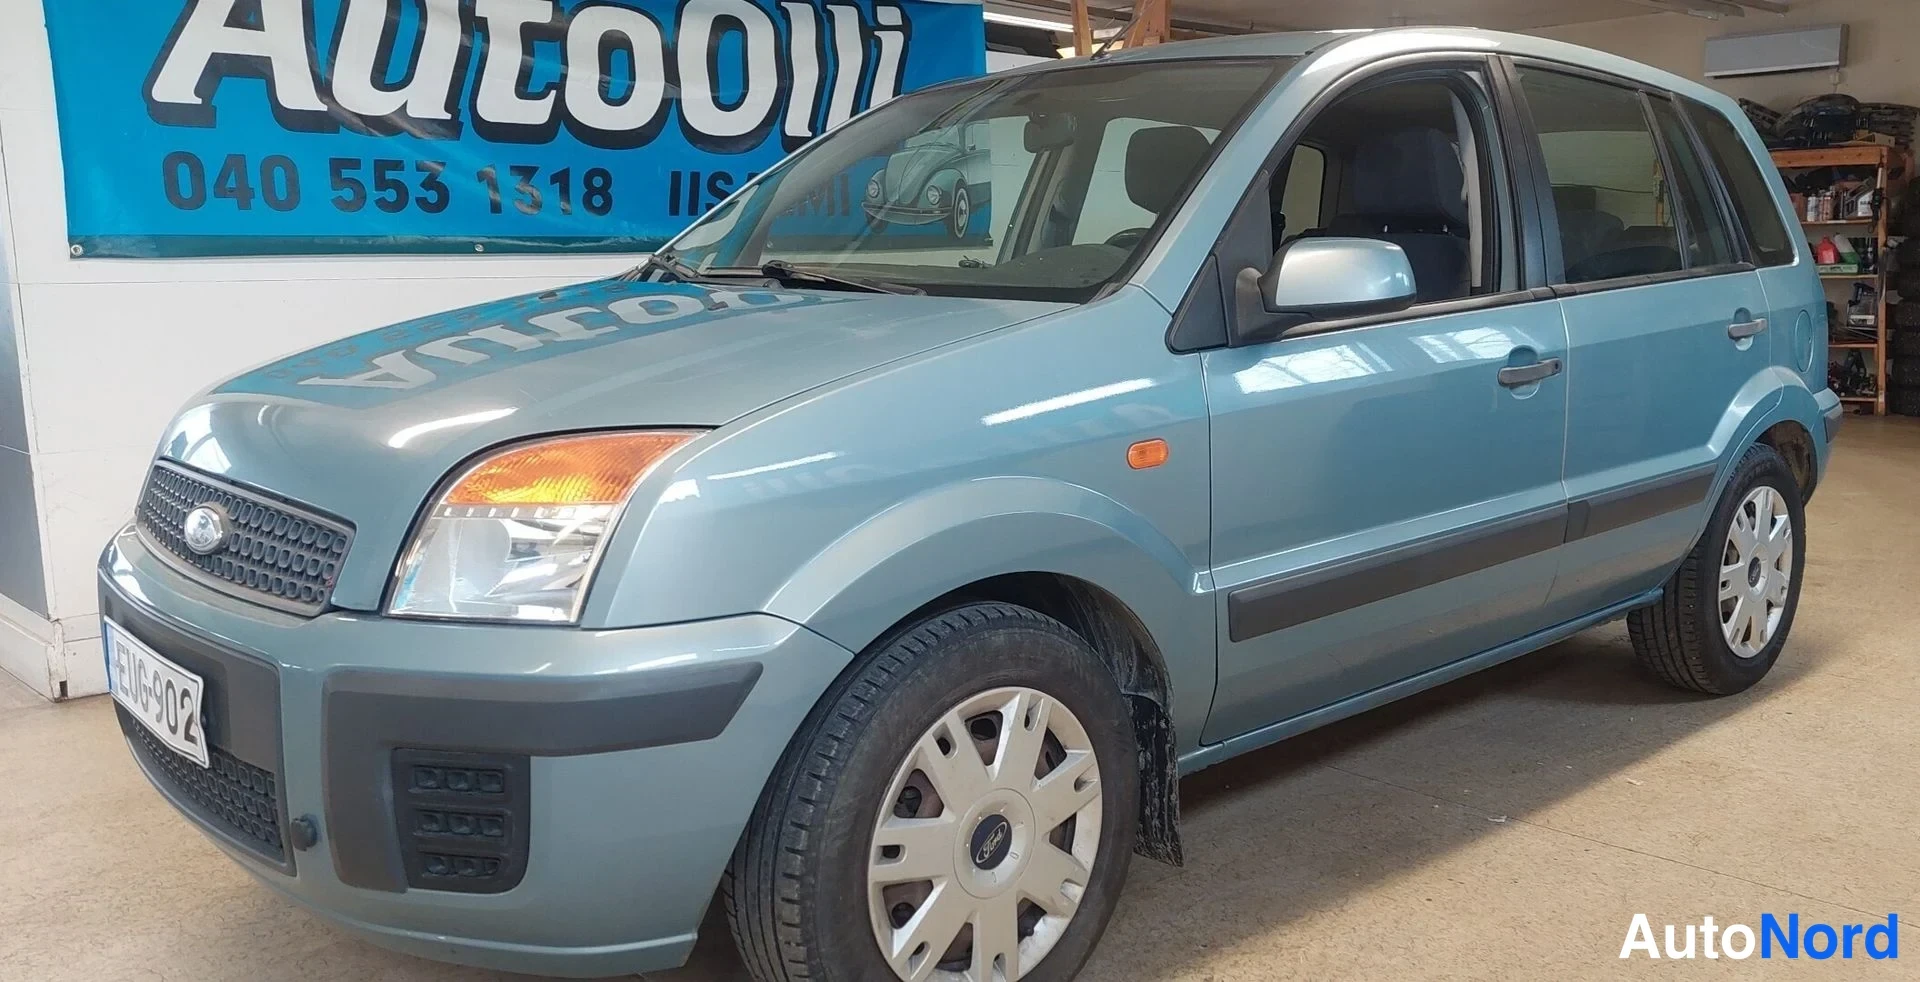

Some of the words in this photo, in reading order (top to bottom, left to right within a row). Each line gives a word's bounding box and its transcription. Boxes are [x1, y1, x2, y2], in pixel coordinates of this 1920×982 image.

[150, 0, 907, 150] AutoOlli
[162, 151, 302, 211] 040
[328, 157, 450, 214] 553
[475, 163, 613, 217] 1318
[115, 640, 199, 746] EUG-902
[980, 826, 1005, 860] Ford
